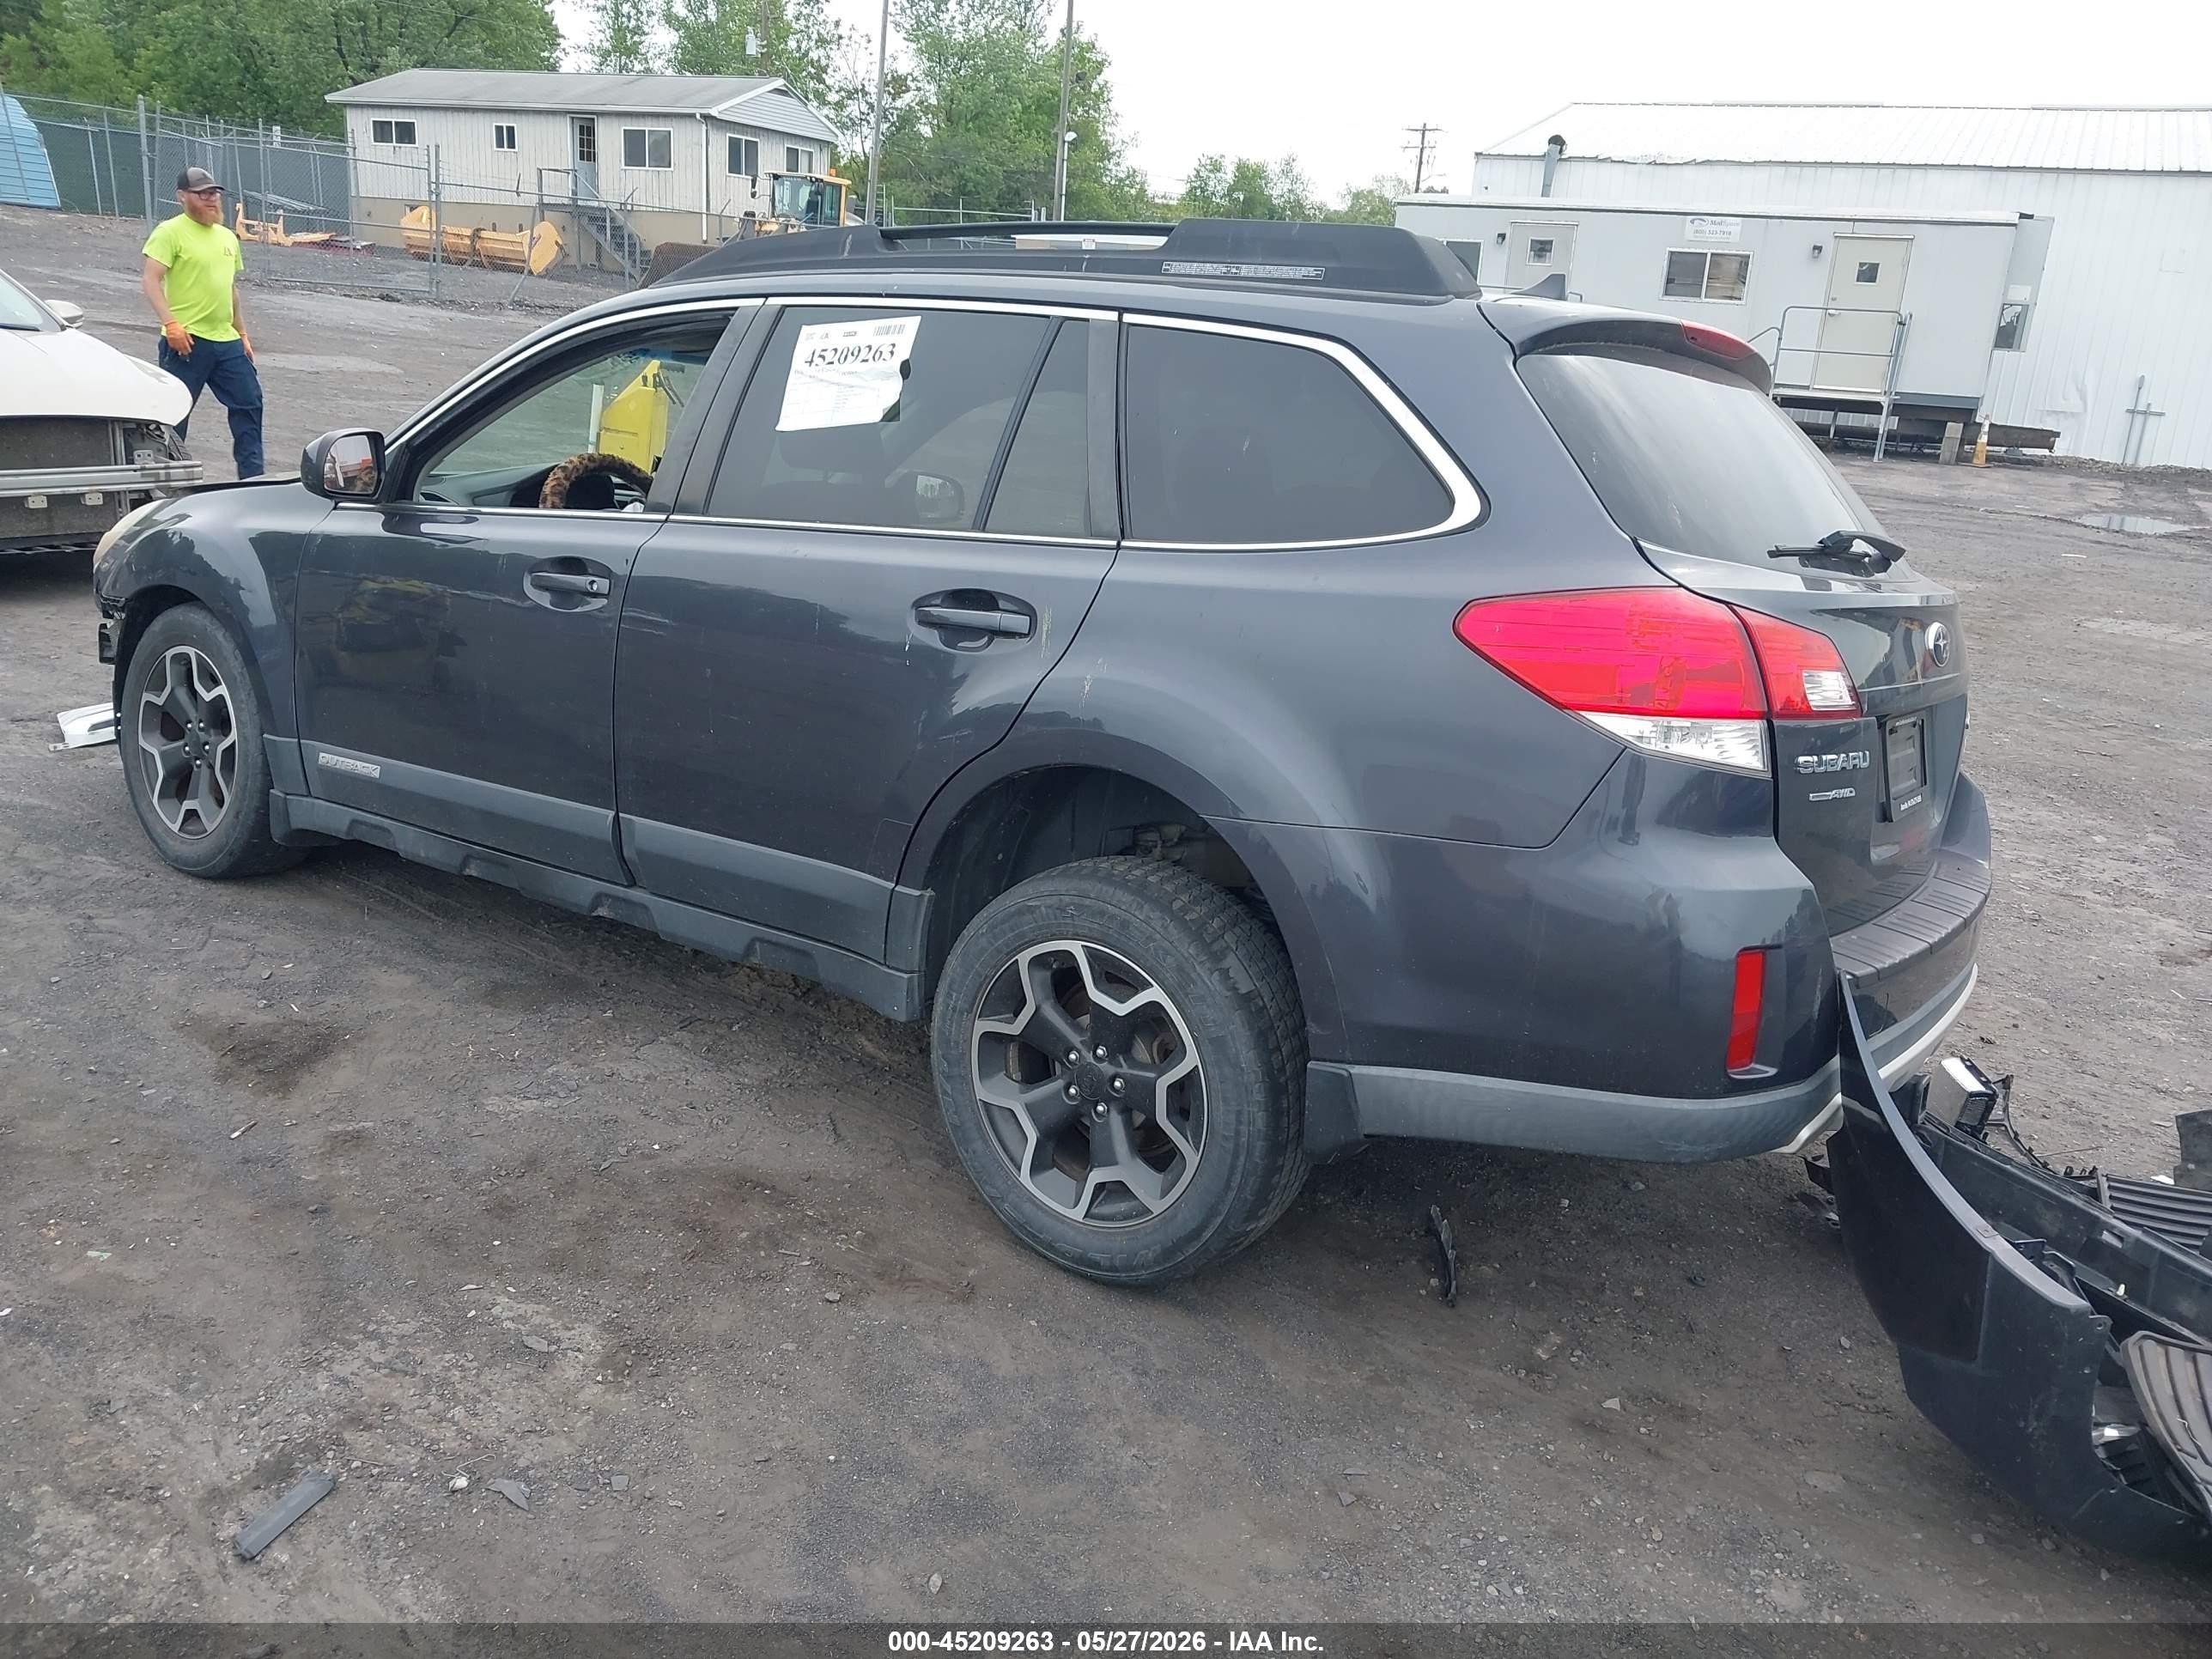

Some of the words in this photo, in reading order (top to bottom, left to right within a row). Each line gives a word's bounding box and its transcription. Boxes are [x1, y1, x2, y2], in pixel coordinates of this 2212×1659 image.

[805, 343, 896, 368] 45209263
[319, 753, 380, 778] OUTBACK
[1795, 750, 1870, 775] SUBARU
[1829, 787, 1856, 799] AWD
